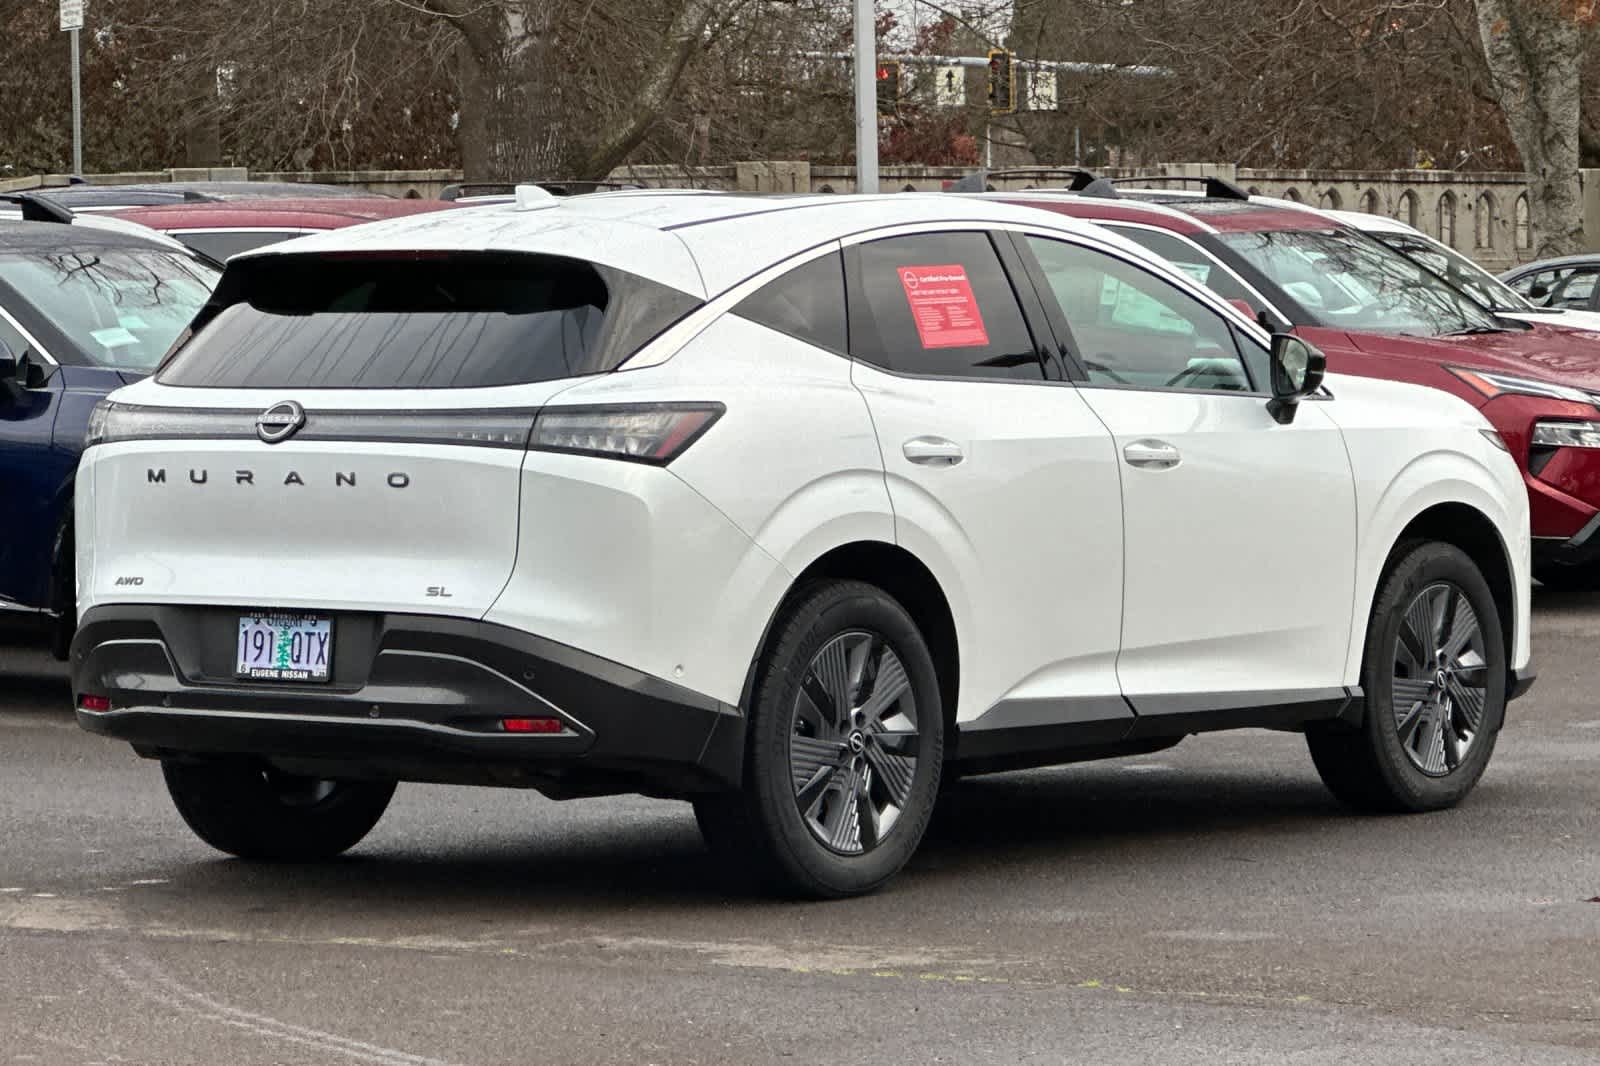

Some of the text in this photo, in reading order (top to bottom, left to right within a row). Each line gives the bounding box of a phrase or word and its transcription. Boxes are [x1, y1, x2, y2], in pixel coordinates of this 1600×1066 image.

[257, 414, 301, 424] NISSAN
[147, 468, 410, 489] MURANO
[115, 576, 144, 586] AWD
[425, 586, 453, 598] SL
[242, 629, 328, 664] 191 QTX
[251, 669, 279, 678] EUGENE
[281, 669, 308, 679] NISSAN
